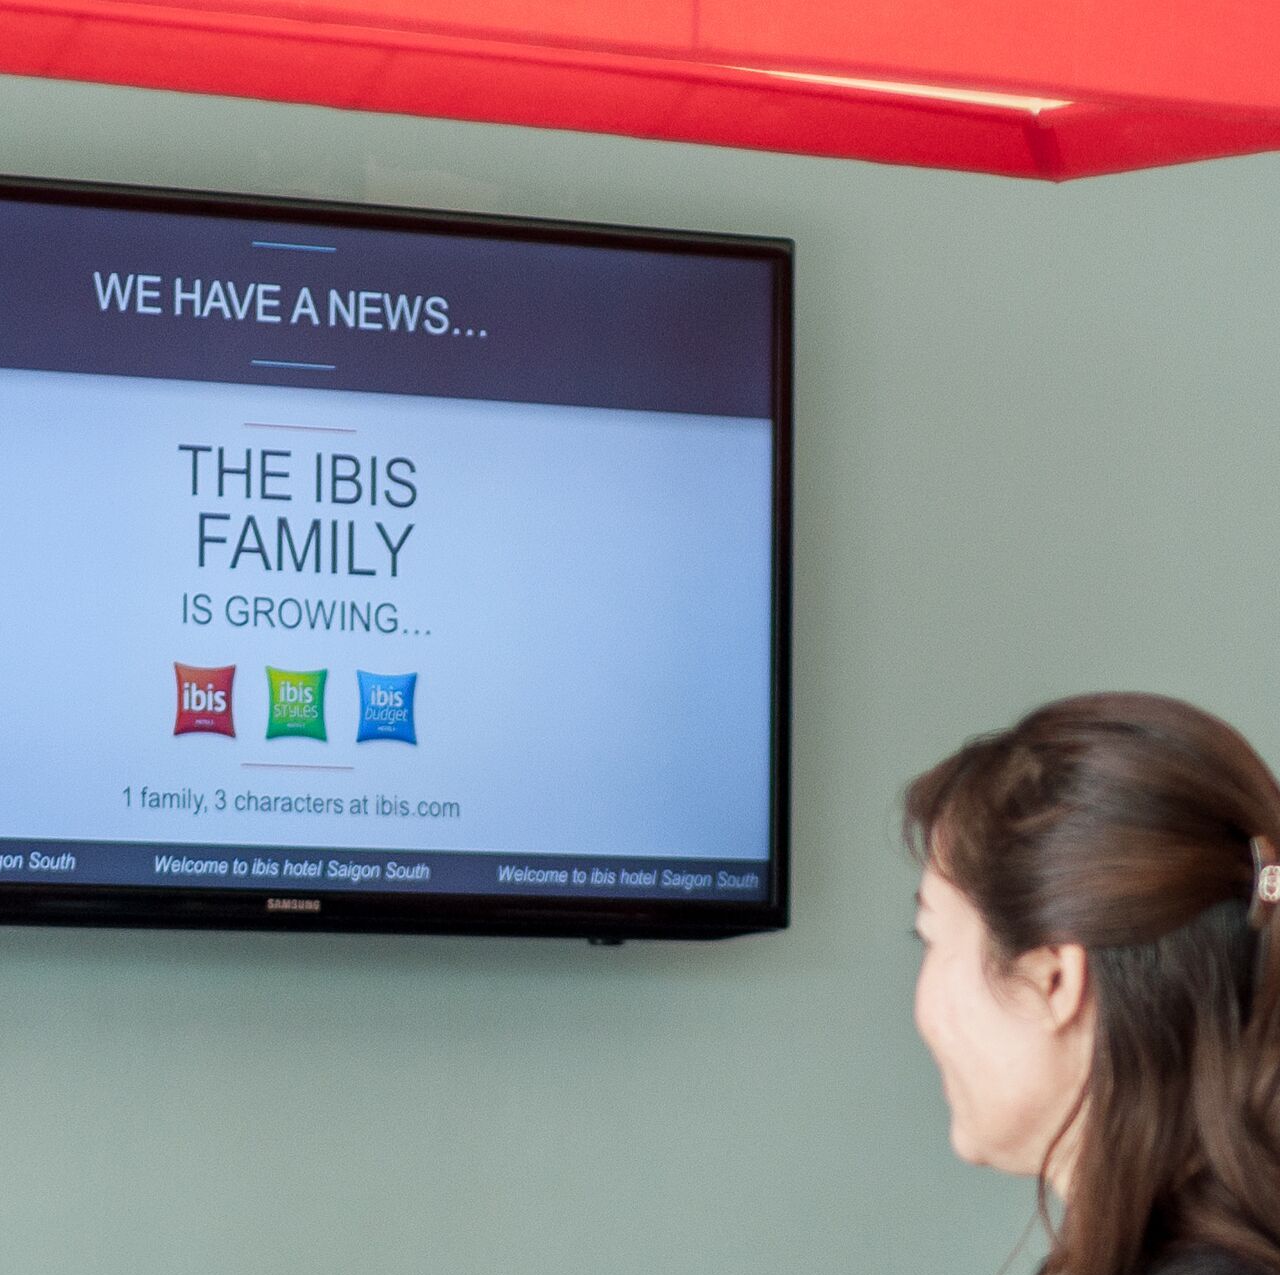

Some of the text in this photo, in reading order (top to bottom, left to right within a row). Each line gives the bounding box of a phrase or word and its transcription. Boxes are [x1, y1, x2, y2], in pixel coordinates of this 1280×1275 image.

[93, 271, 487, 337] WE HAVE A NEWS...
[178, 444, 417, 508] THE IBIS
[198, 512, 415, 577] FAMILY
[182, 593, 431, 635] IS GROWING...
[183, 682, 226, 712] ibis
[279, 681, 314, 704] ibis
[371, 685, 403, 708] ibis
[122, 786, 460, 818] 1 family, 3 characters at ibis.com
[28, 851, 76, 871] South
[155, 855, 431, 881] Welcome to ibis hotel Saigon South
[498, 865, 759, 890] Welcome to ibis hotel Saigon South
[267, 898, 320, 912] SAMSUNG
